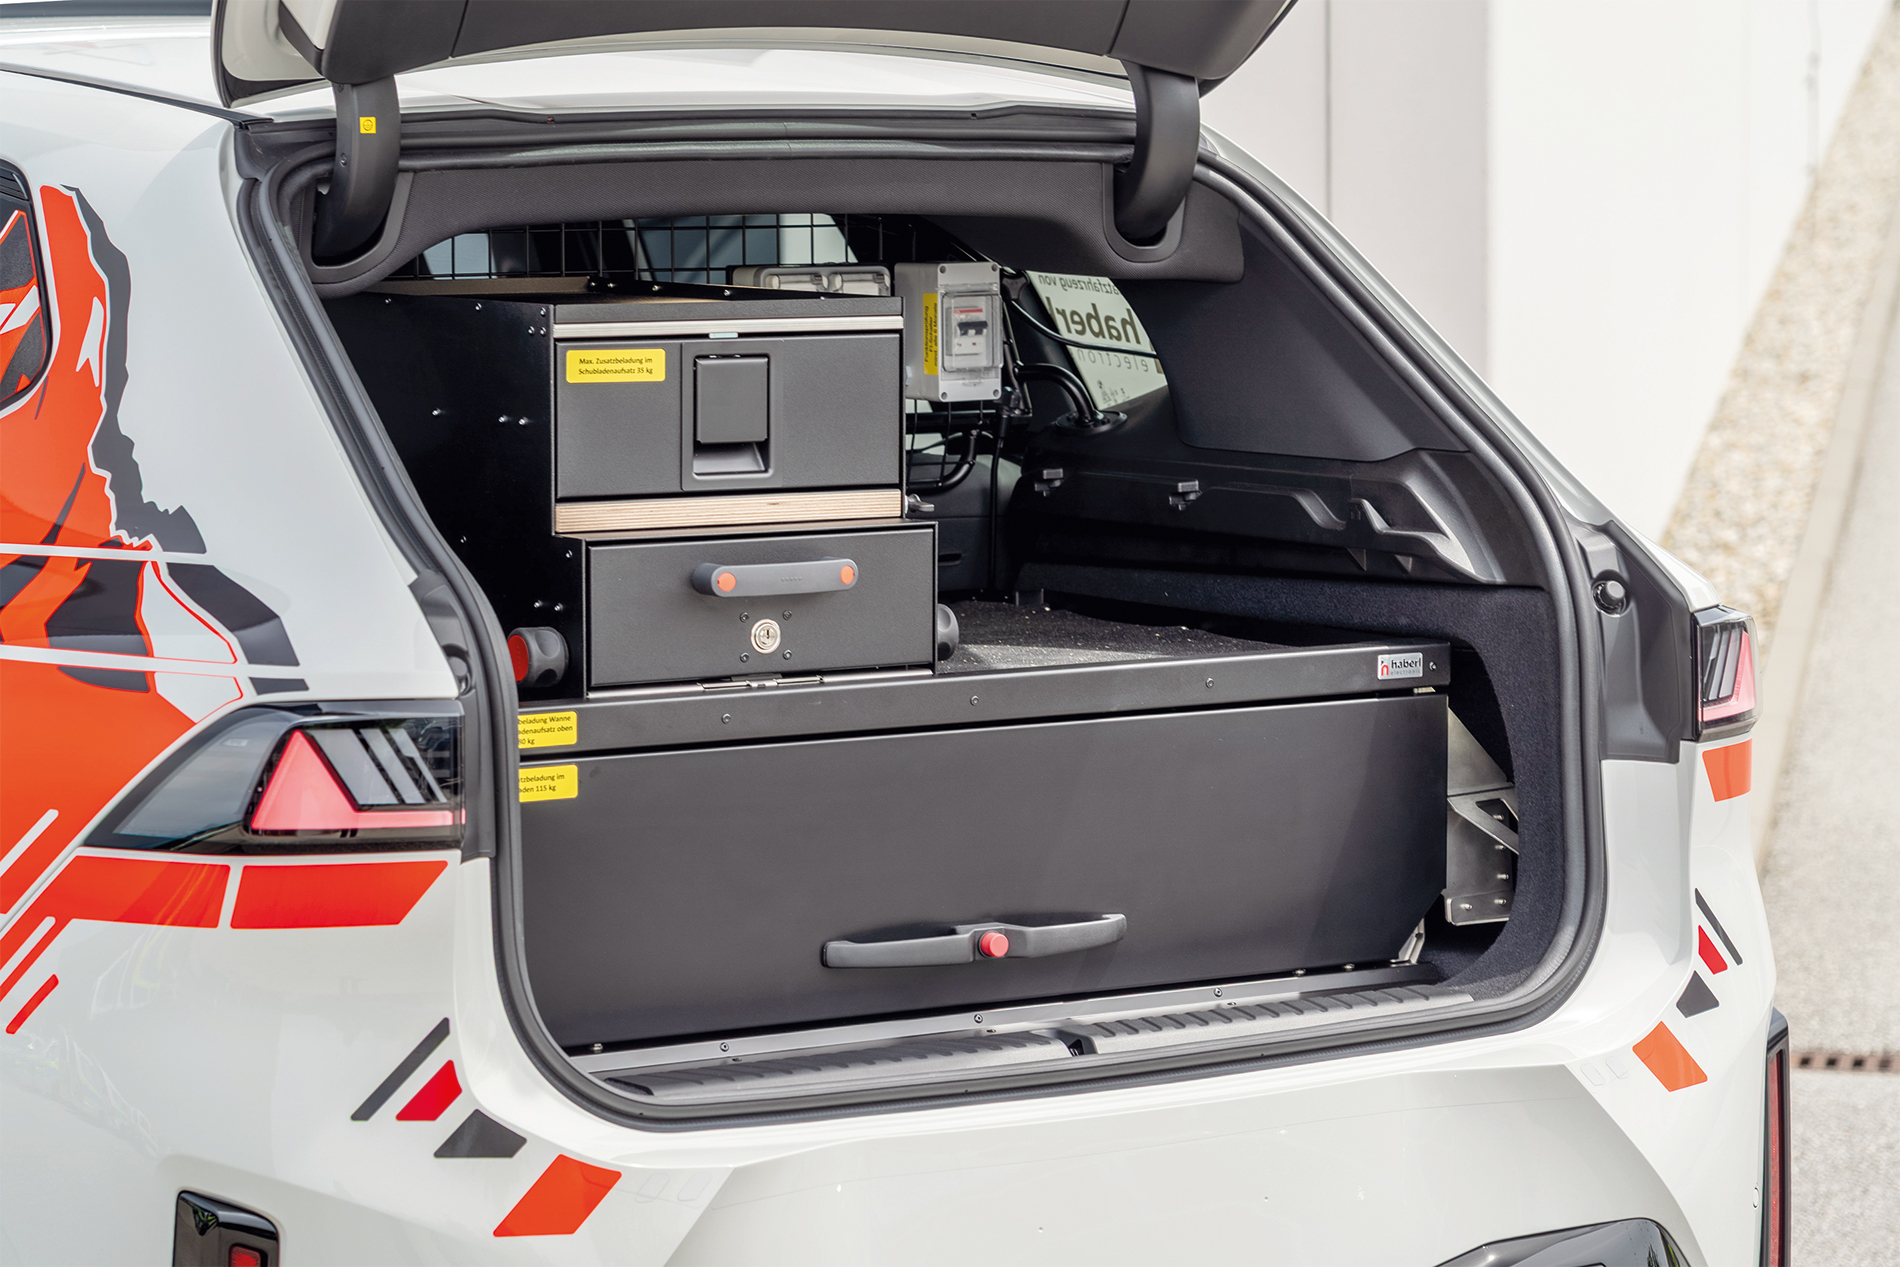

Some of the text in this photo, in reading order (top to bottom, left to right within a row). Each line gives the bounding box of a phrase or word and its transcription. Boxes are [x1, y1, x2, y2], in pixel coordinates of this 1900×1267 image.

[596, 357, 643, 365] Zusatzbeladung
[578, 367, 635, 375] Schubladenaufsatz
[646, 367, 653, 375] kg
[1391, 658, 1421, 668] haberl
[548, 784, 556, 792] kg
